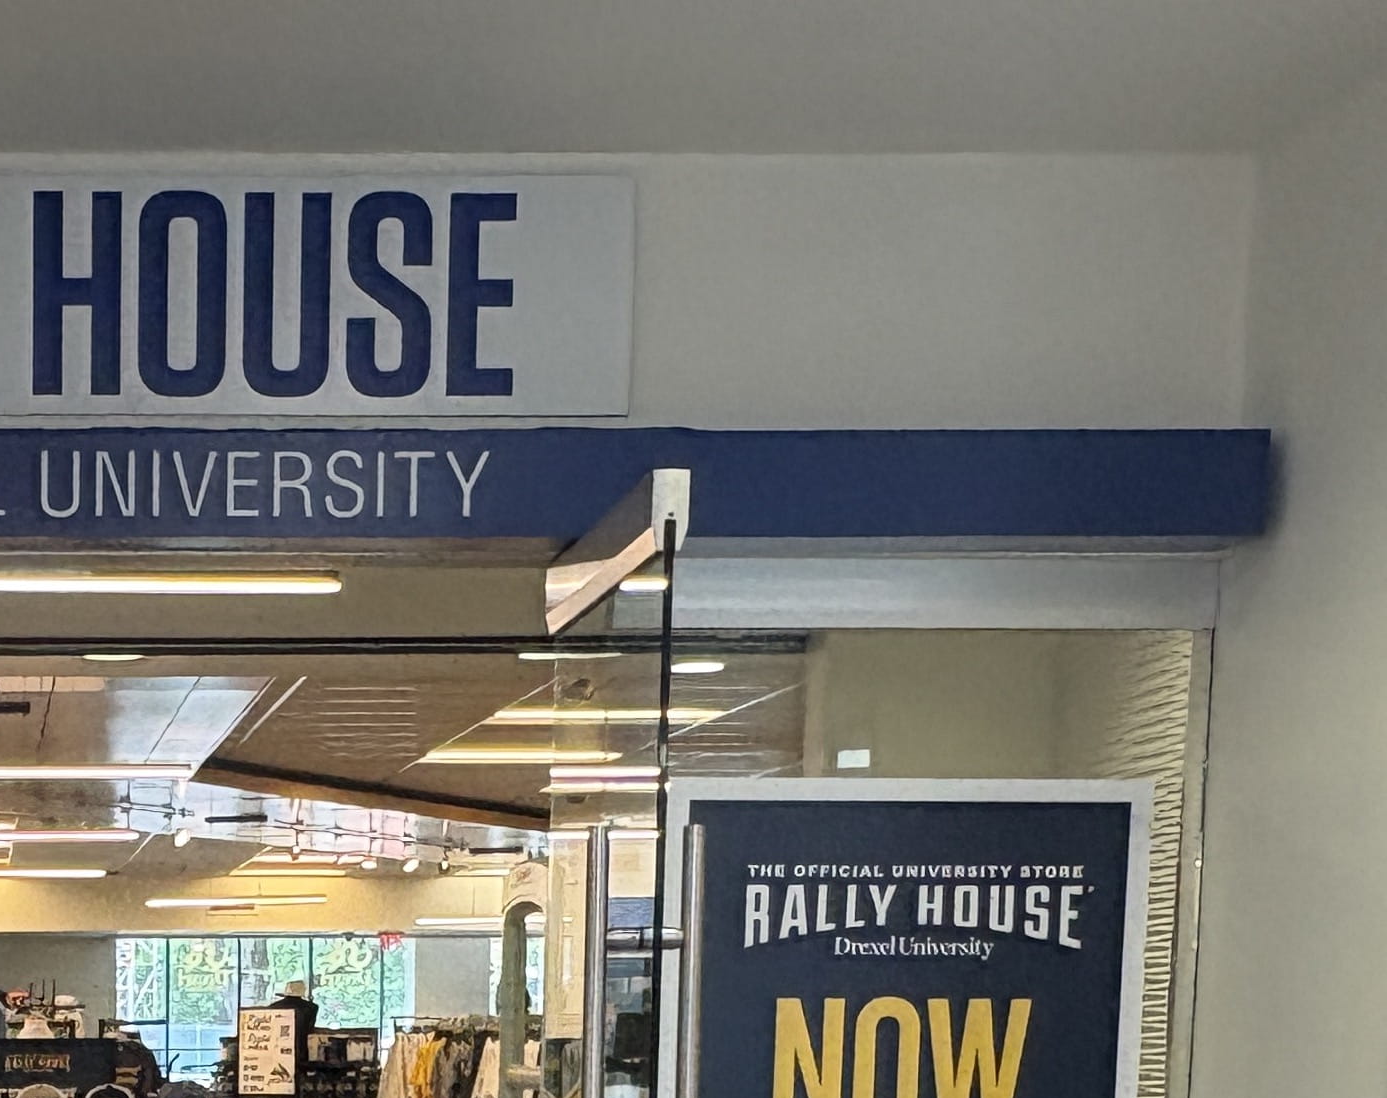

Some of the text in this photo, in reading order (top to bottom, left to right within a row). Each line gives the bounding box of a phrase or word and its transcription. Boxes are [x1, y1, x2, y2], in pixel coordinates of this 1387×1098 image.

[31, 188, 519, 398] HOUSE
[38, 449, 493, 521] UNIVERSITY
[747, 863, 1085, 880] THE OFFICIAL UNIVERSITY STORE
[743, 883, 1084, 950] RALLY HOUSE
[833, 934, 995, 961] Drexel University
